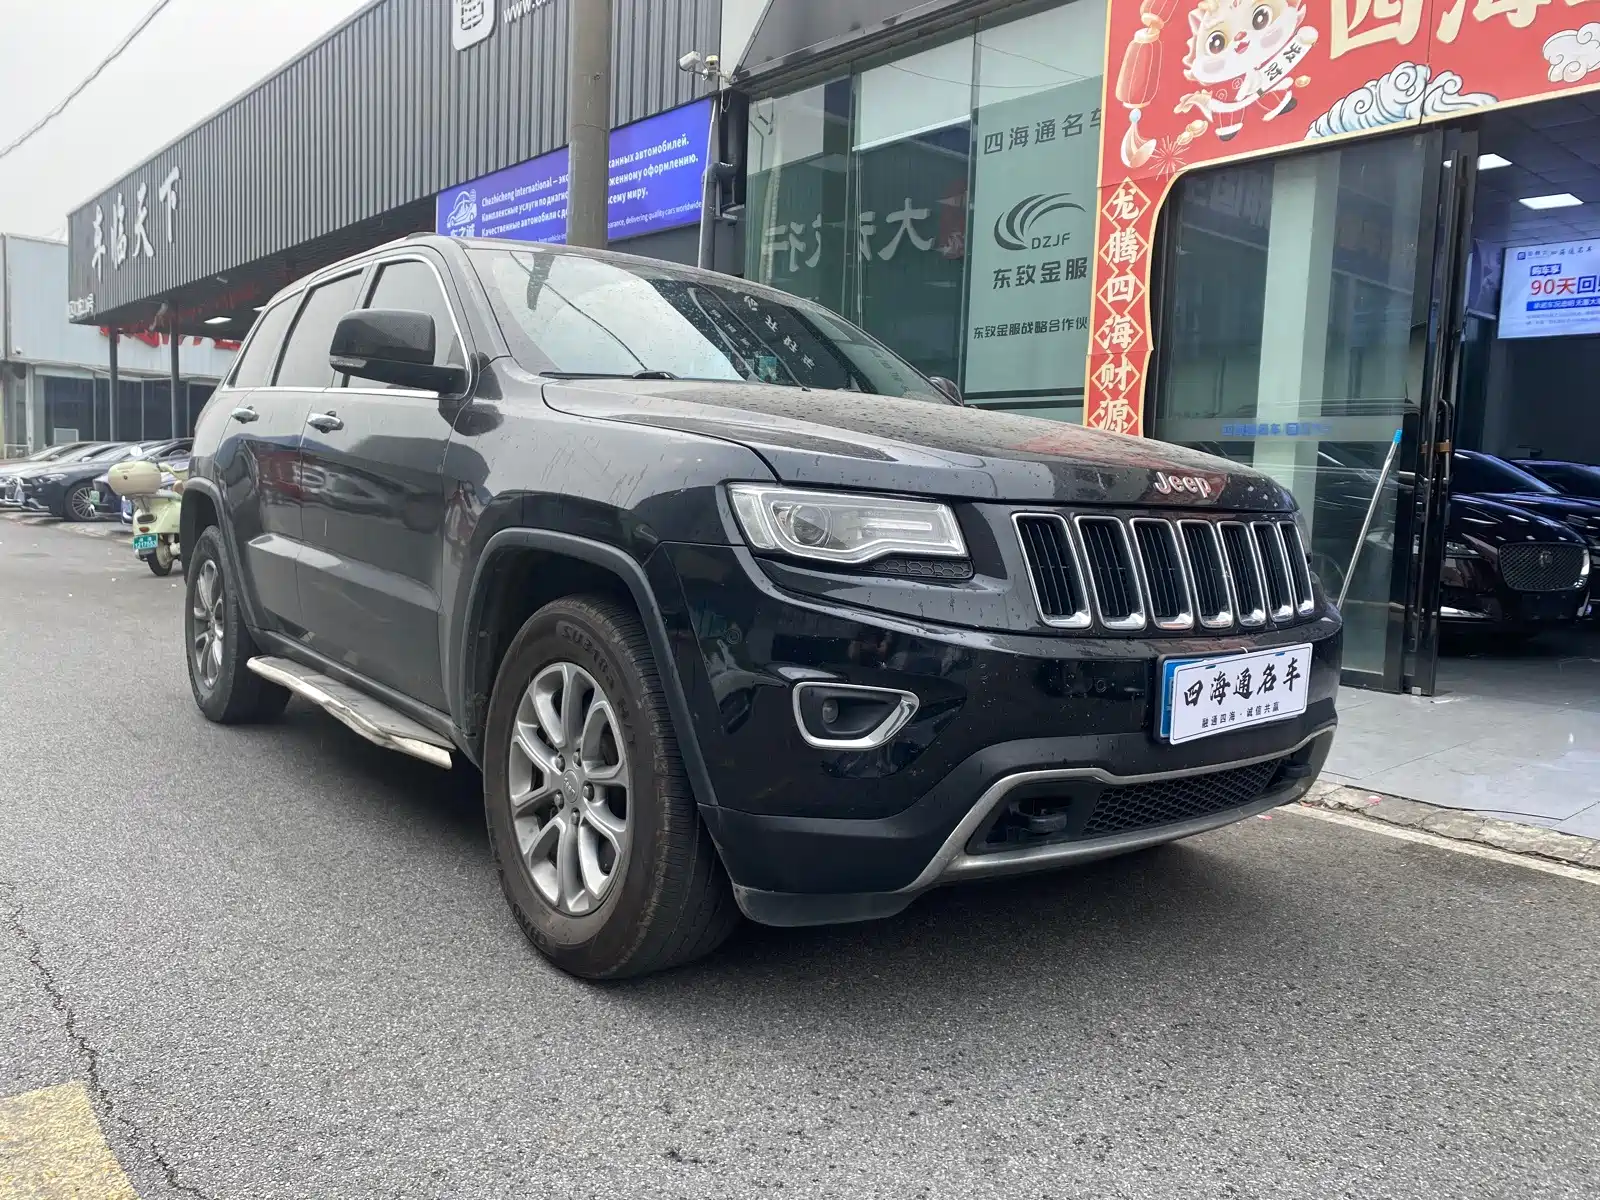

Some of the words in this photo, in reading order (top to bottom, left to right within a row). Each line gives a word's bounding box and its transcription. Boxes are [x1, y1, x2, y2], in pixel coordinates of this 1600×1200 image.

[1264, 42, 1302, 81] 发财
[482, 190, 514, 207] Chezhicheng
[515, 177, 552, 197] International
[635, 133, 689, 160] автомобилей.
[482, 205, 518, 222] Комплексные
[519, 199, 538, 214] услуги
[539, 198, 546, 207] по
[643, 153, 698, 177] оформлению.
[482, 222, 520, 237] Качественные
[520, 211, 556, 227] автомобили
[627, 186, 648, 199] миру.
[665, 207, 675, 215] cars
[1031, 232, 1071, 250] DZJF
[993, 257, 1088, 289] 东致金服
[1531, 276, 1600, 295] 90天回
[973, 316, 1088, 339] 东致金服战略合作伙
[1099, 188, 1140, 434] 龙腾四海财源
[1153, 471, 1212, 498] Jeep
[1184, 657, 1301, 706] 四海通名车
